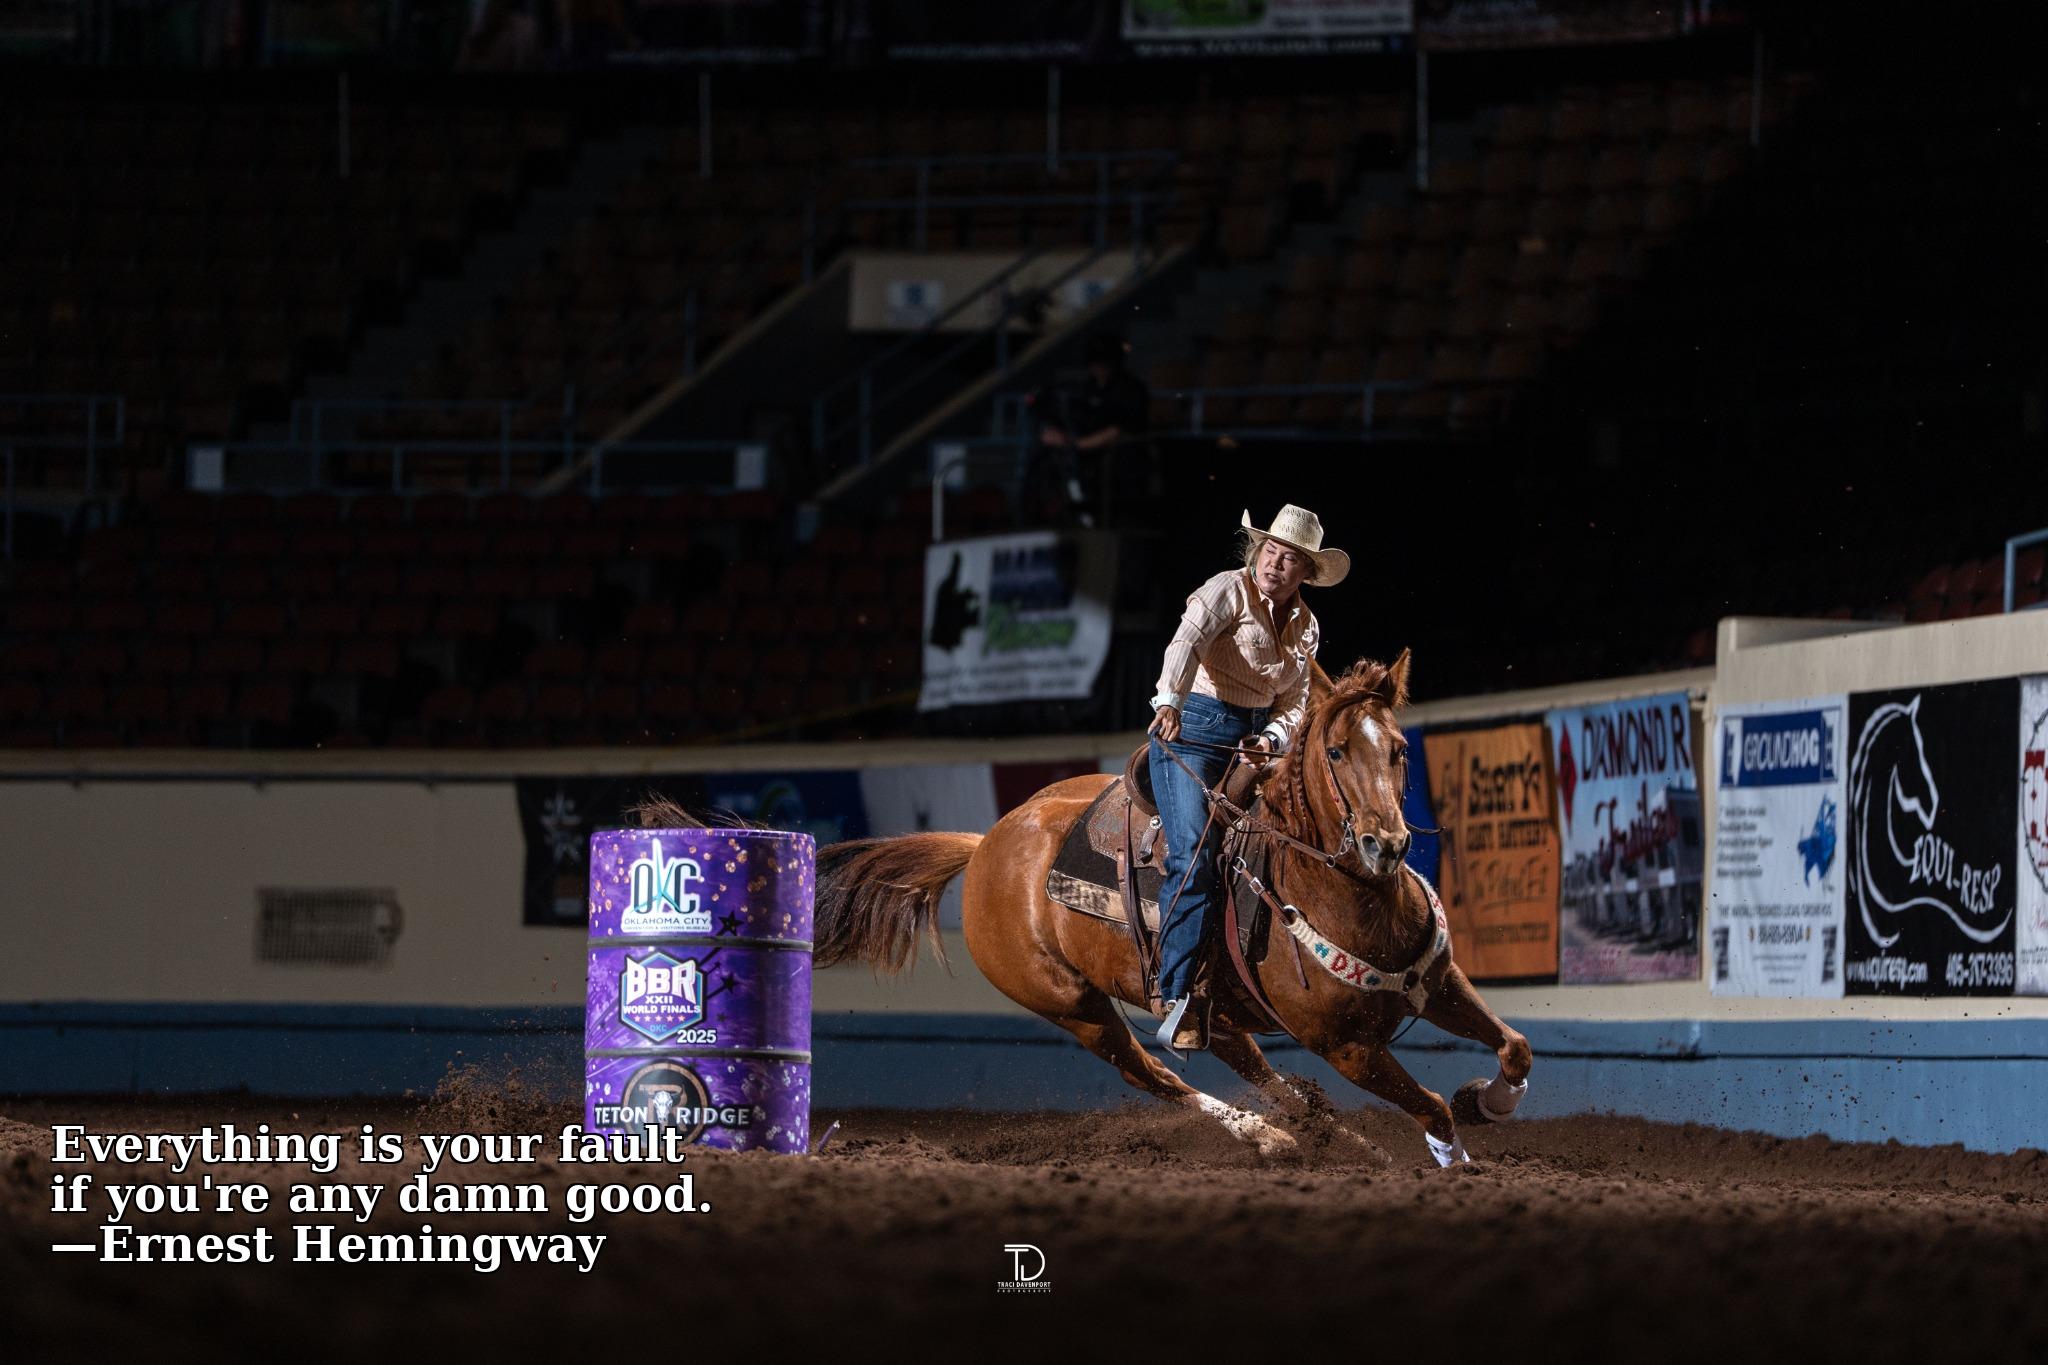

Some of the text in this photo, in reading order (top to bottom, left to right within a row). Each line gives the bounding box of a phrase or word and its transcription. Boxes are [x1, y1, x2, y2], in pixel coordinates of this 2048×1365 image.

[1671, 703, 1690, 772] R
[1743, 728, 1820, 771] GROUNDHOG
[630, 838, 698, 914] OKC
[1909, 833, 2001, 914] EQUI-RESP
[624, 917, 708, 925] OKLAHOMA CITY
[626, 957, 696, 1005] BBR
[1330, 954, 1369, 985] DX
[623, 1005, 701, 1014] WORLD FINALS
[645, 996, 673, 1004] XXII
[649, 1024, 667, 1032] OKC
[676, 1029, 717, 1044] 2025
[594, 1106, 750, 1125] TETON RIDGE
